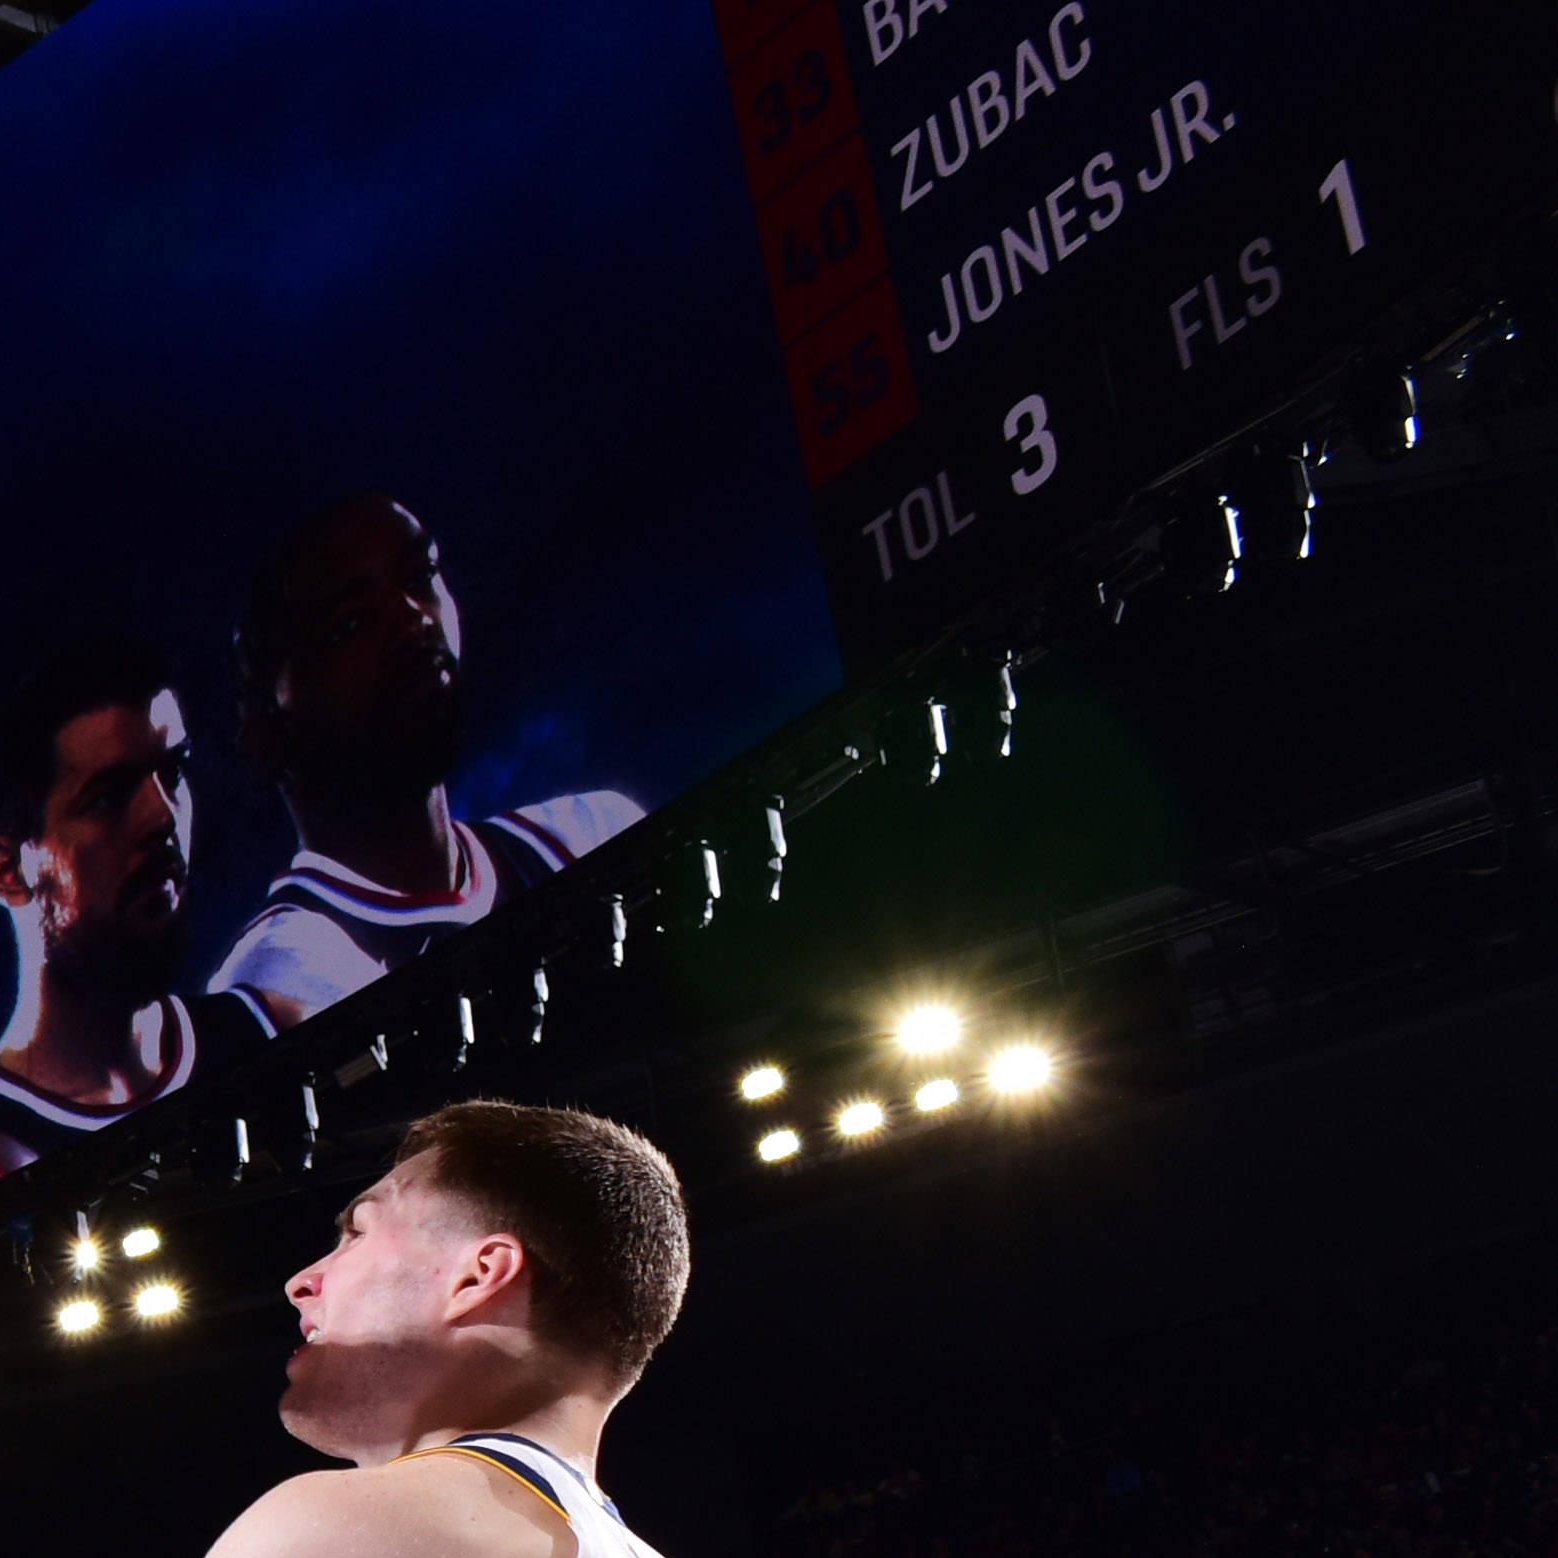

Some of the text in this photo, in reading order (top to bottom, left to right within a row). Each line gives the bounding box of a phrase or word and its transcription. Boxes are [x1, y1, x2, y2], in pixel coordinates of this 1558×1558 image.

[890, 2, 1092, 212] ZUBAC
[929, 151, 1124, 353] JONES
[1138, 79, 1237, 192] JR.
[1168, 158, 1367, 369] FLS 1
[862, 394, 1059, 582] TOL 3
